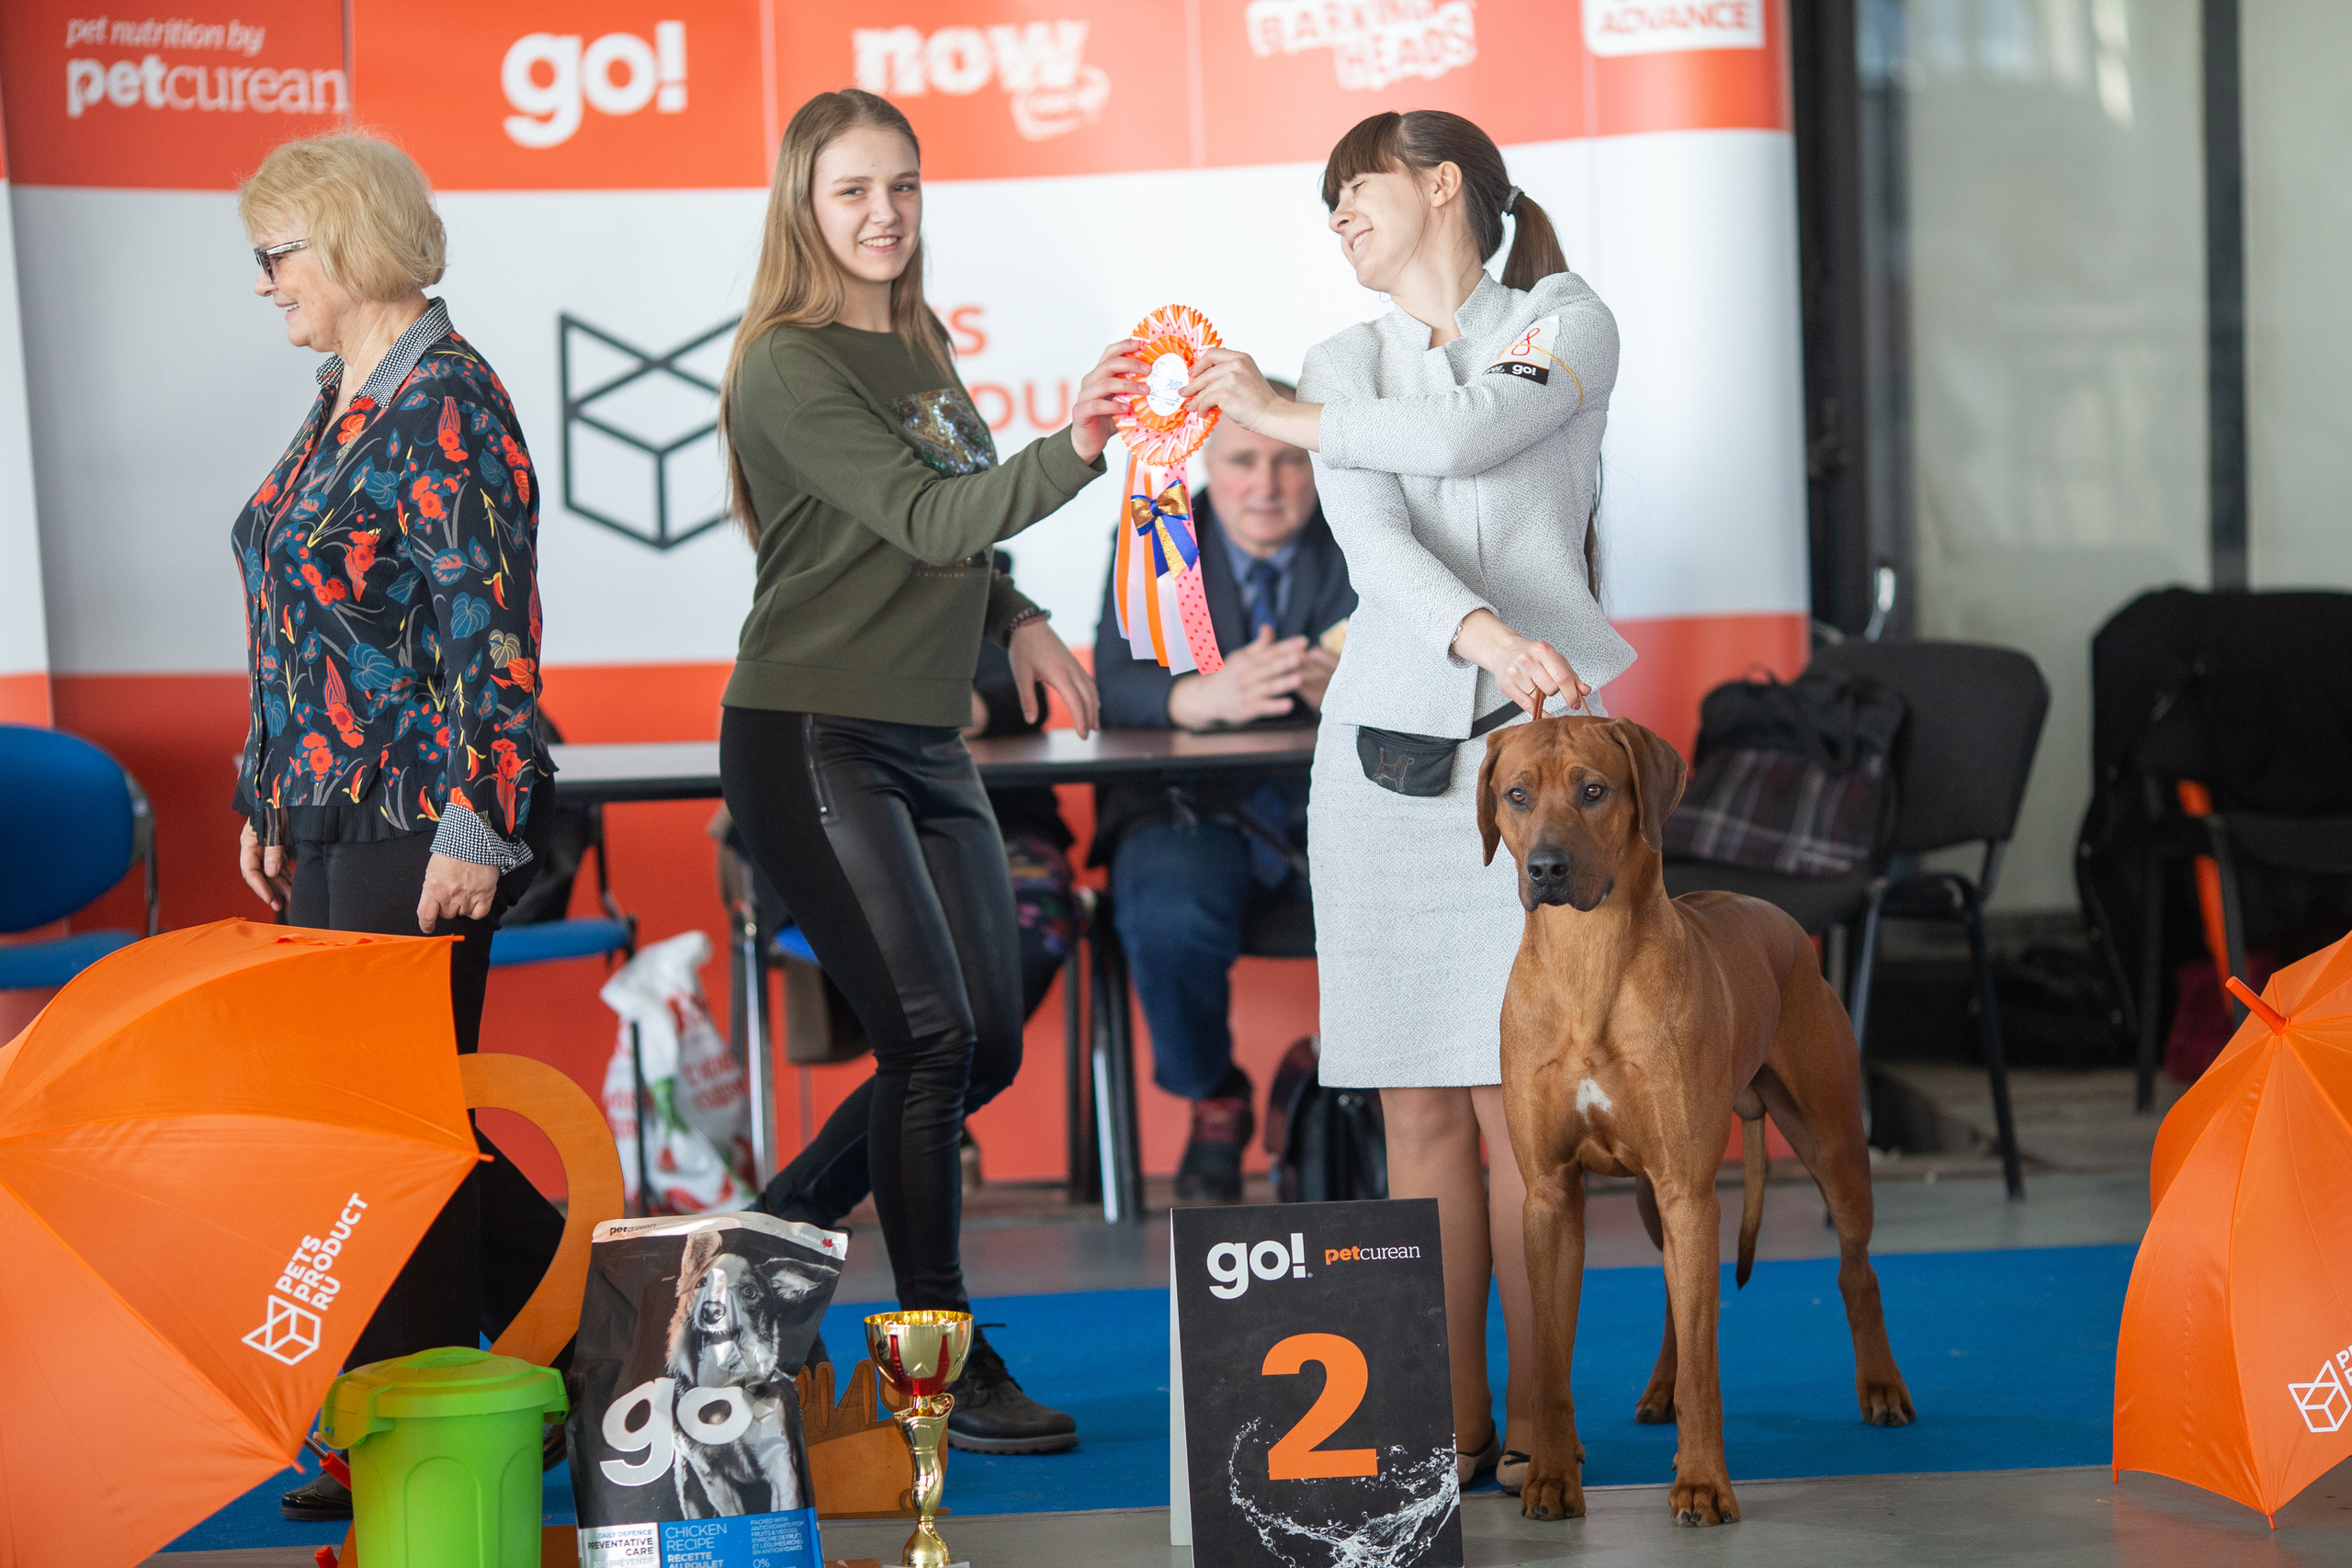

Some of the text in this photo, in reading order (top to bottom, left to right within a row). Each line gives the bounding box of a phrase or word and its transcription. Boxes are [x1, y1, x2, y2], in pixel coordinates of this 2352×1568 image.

[1599, 1, 1754, 35] ADVANCE
[66, 16, 266, 58] pet nutrition by
[852, 19, 1091, 97] now
[66, 54, 348, 118] petcurean
[503, 21, 686, 148] go!
[1511, 364, 1537, 376] go!
[275, 1235, 322, 1294] PETS
[292, 1192, 368, 1303] PRODUCT
[1324, 1243, 1421, 1266] petcurean
[1206, 1232, 1307, 1300] go!
[310, 1276, 341, 1311] RU
[1261, 1332, 1378, 1481] 2
[587, 1537, 653, 1550] PREVENTATIVE
[665, 1523, 727, 1539] CHICKEN
[666, 1537, 715, 1551] RECIPE
[626, 1547, 654, 1556] CARE
[667, 1551, 712, 1562] RECETTE
